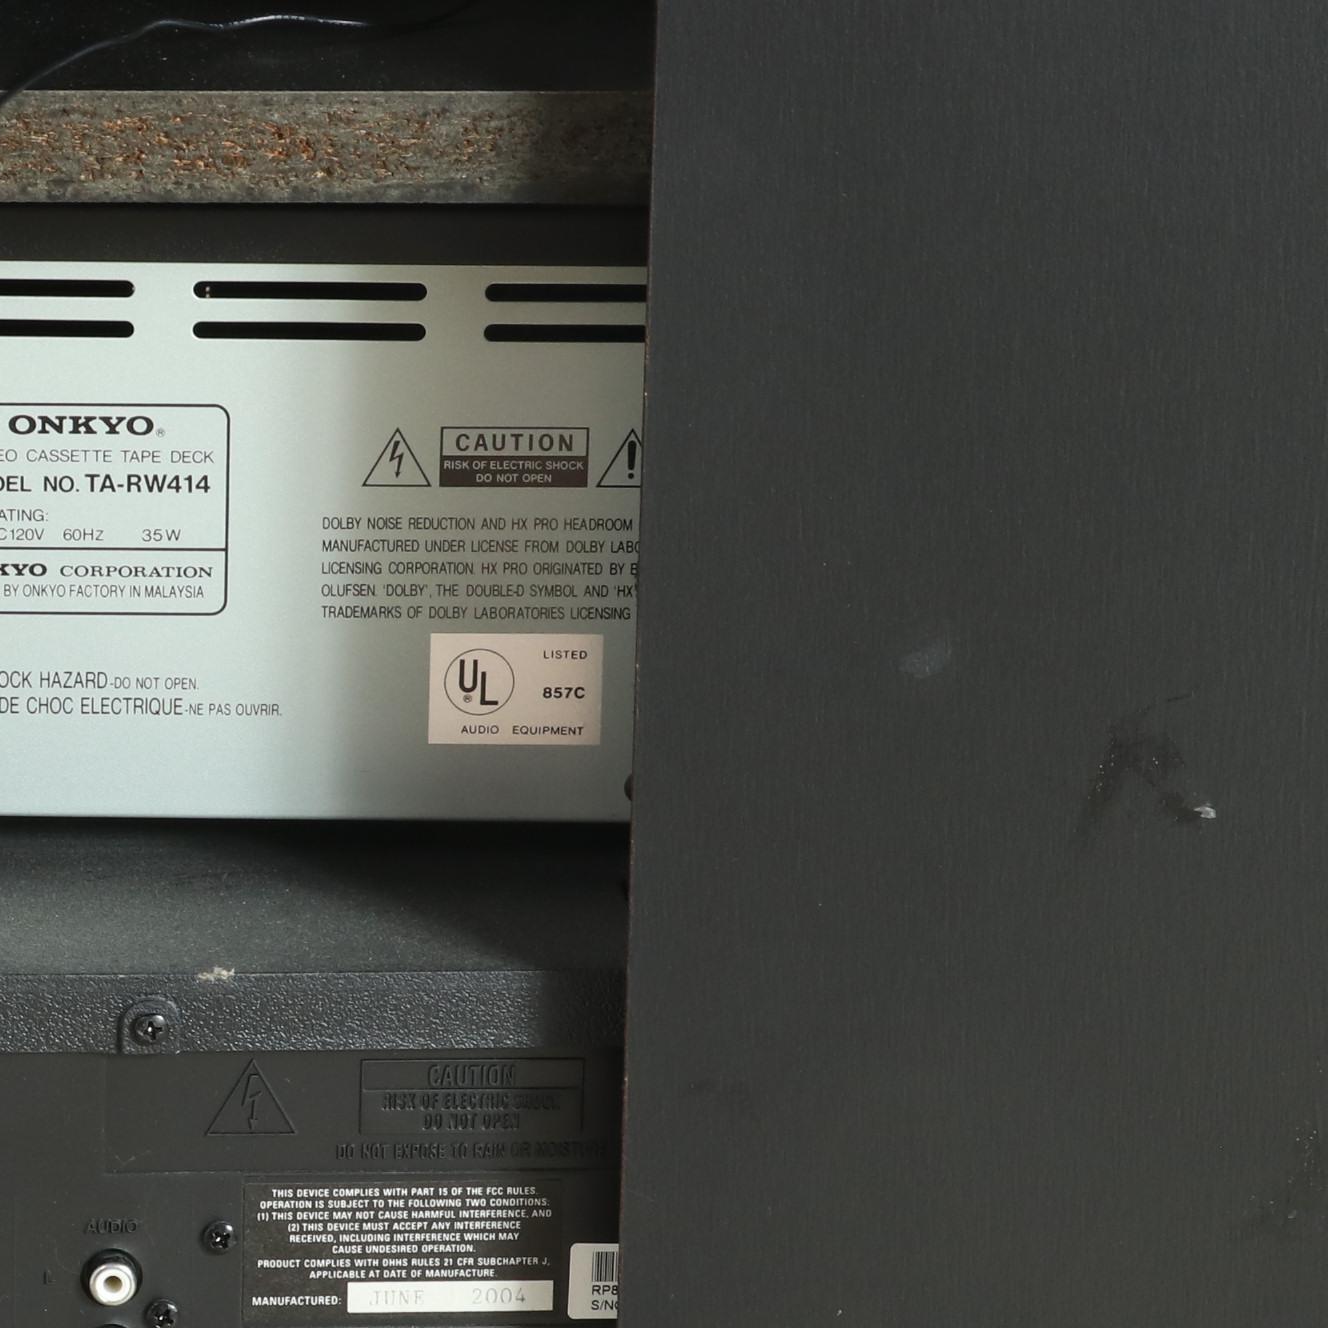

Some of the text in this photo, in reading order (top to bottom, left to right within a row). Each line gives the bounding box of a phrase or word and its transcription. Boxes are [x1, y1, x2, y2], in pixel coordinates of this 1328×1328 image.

[8, 415, 154, 436] ONKYO
[455, 433, 573, 451] CAUTION
[26, 449, 112, 463] CASSETTE
[121, 450, 161, 464] TAPE
[170, 450, 215, 464] DECK
[443, 460, 584, 470] RISK OF ELECTRIC SHOCK
[44, 474, 80, 492] NO.
[85, 474, 211, 492] TA-RW414
[476, 473, 552, 483] DO NOT OPEN
[322, 517, 632, 531] DOLBY NOISE REDUCTION AND HX PRO HEADROOM
[59, 564, 213, 579] CORPORATION
[4, 584, 19, 597] BY
[22, 584, 66, 597] ONKYO
[69, 585, 123, 598] FACTORY
[129, 585, 141, 598] IN
[144, 585, 204, 598] MALAYSIA
[322, 606, 631, 621] TRADEMARKS OF DOLBY LABORATORIES LICENSING
[544, 651, 588, 660] LISTED
[135, 677, 160, 689] NOT
[164, 677, 199, 689] OPEN.
[543, 687, 585, 699] 857C
[27, 697, 74, 714] CHOC
[209, 703, 232, 715] PAS
[235, 703, 282, 715] OUVRIR.
[461, 725, 584, 736] AUDIO EQUIPMENT
[428, 1065, 515, 1086] CAUTION
[447, 1114, 475, 1130] NOT
[483, 1114, 520, 1130] OPEN
[272, 1188, 293, 1198] THIS
[297, 1188, 330, 1198] DEVICE
[333, 1187, 380, 1197] COMPLIES
[383, 1187, 407, 1197] WITH
[411, 1187, 434, 1197] PART
[439, 1186, 448, 1196] 15
[451, 1186, 463, 1196] OF
[467, 1186, 483, 1196] THE
[486, 1186, 503, 1196] FCC
[86, 1219, 138, 1234] AUDIO
[288, 1221, 521, 1232] (2) THIS DEVICE MUST ACCEPT ANY INTERFERENCE
[332, 1244, 476, 1254] CAUSE UNDESIRED OPERATION.
[252, 1297, 342, 1306] MANUFACTURED:
[472, 1288, 527, 1304] 2004
